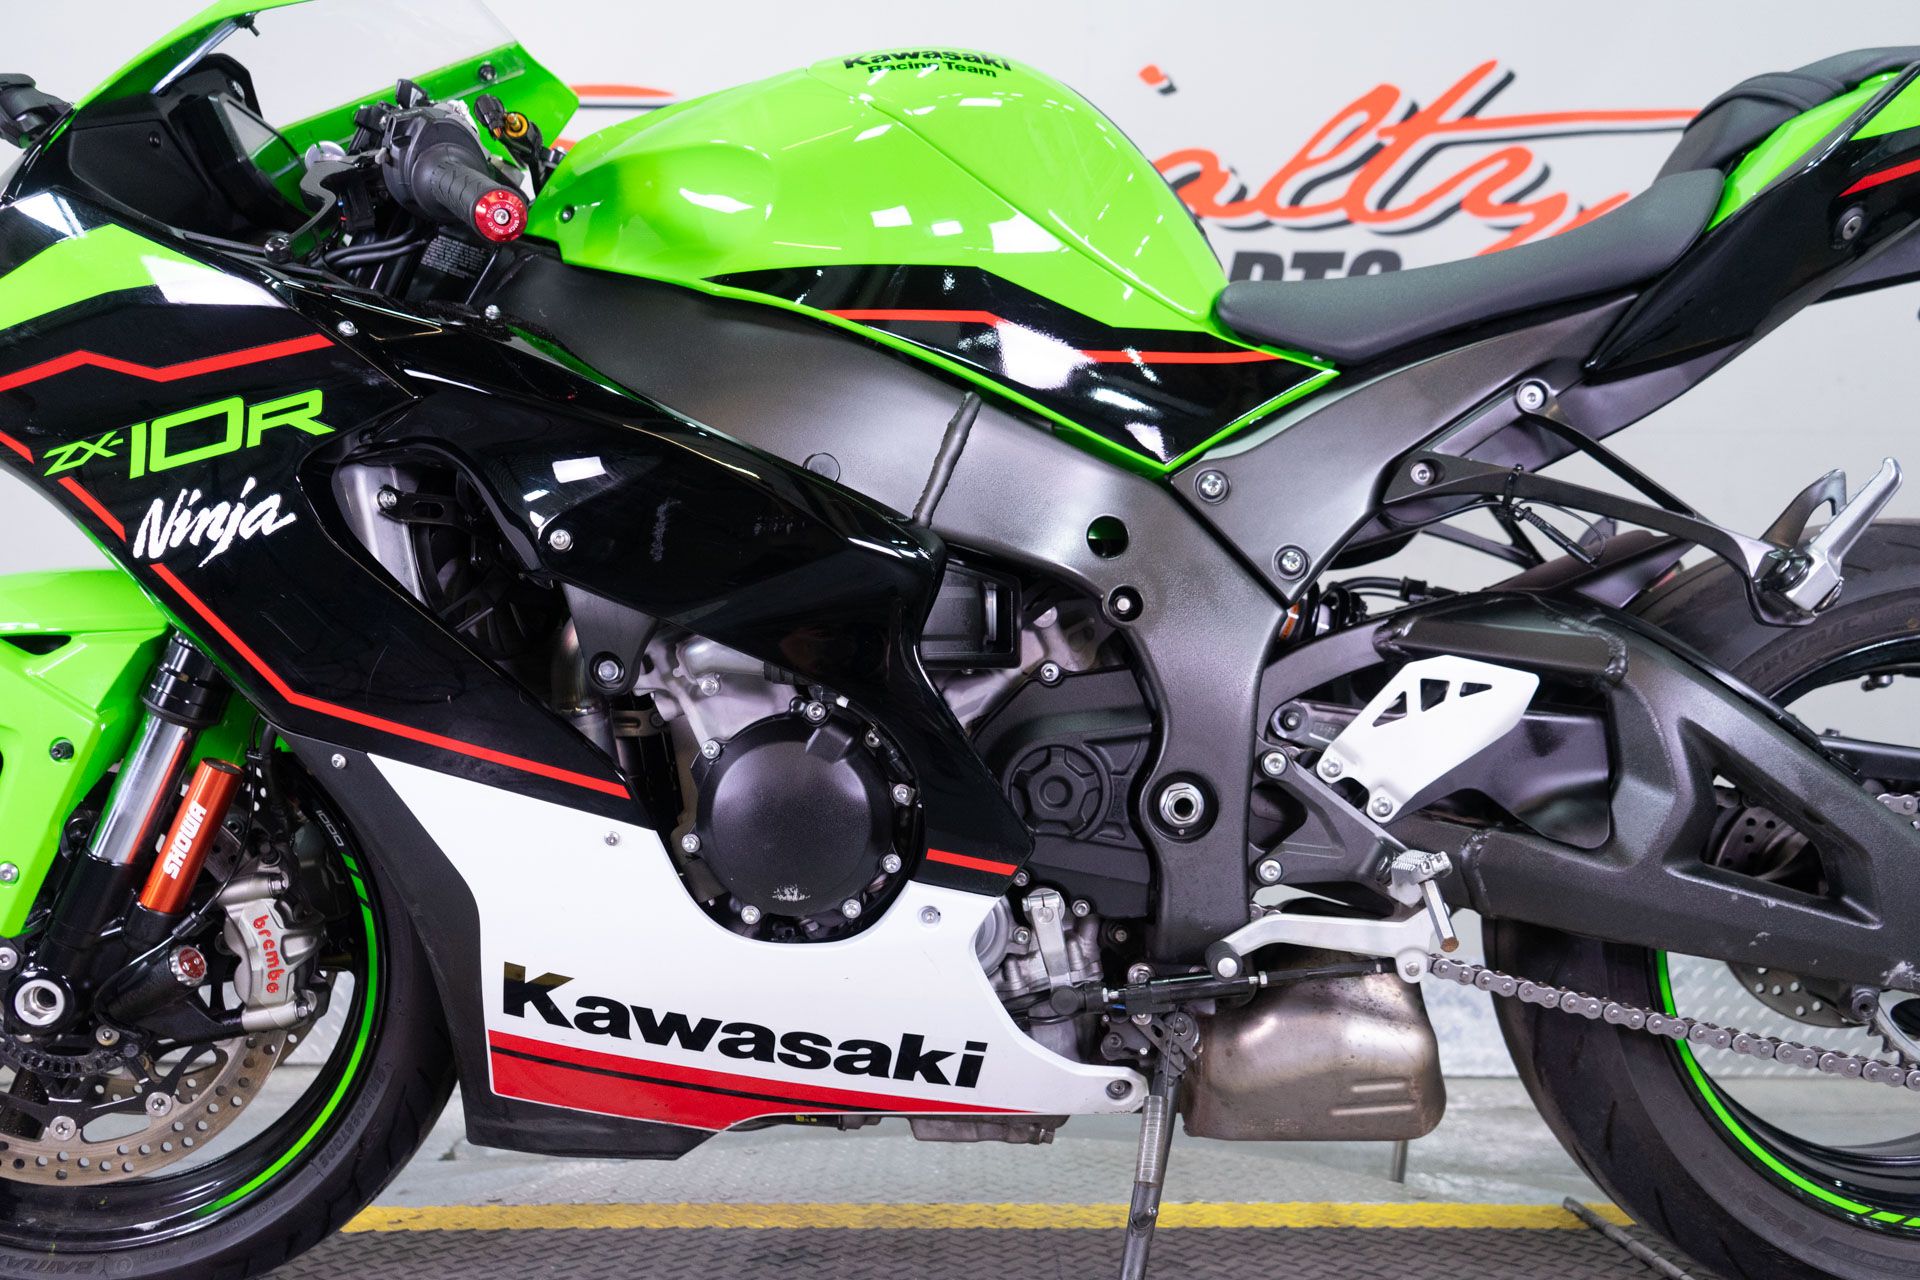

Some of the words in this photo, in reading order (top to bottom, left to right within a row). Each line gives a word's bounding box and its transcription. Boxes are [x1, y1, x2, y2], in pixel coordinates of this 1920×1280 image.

[843, 50, 1012, 72] Kawasaki
[943, 62, 997, 78] Team
[132, 476, 297, 568] Ninja
[163, 800, 208, 880] SHOWA
[253, 914, 285, 994] brembo
[503, 961, 989, 1088] Kawasaki
